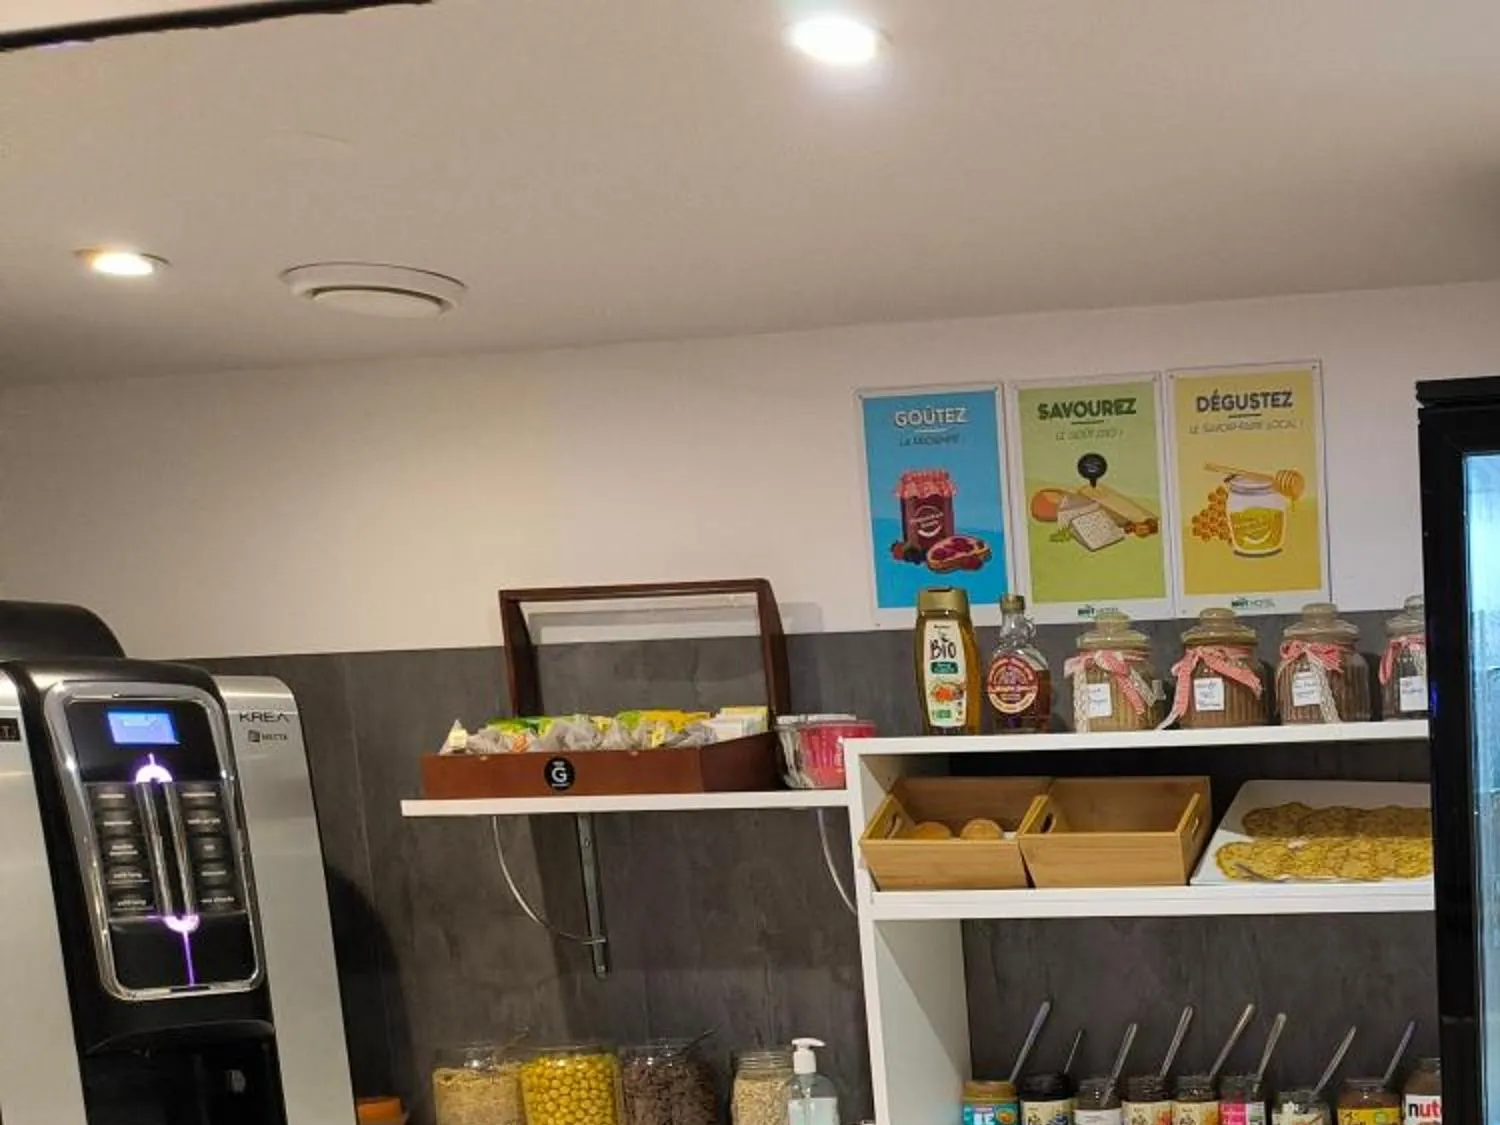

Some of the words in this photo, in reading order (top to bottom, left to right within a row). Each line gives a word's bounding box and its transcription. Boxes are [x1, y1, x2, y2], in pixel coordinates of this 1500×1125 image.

[1196, 388, 1293, 412] DÉGUSTEZ
[895, 404, 968, 428] GOÛTEZ
[1037, 398, 1136, 420] SAVOUREZ
[239, 711, 288, 723] KREA
[551, 767, 568, 783] G
[1408, 1101, 1441, 1117] nut
[973, 1112, 995, 1125] BE
